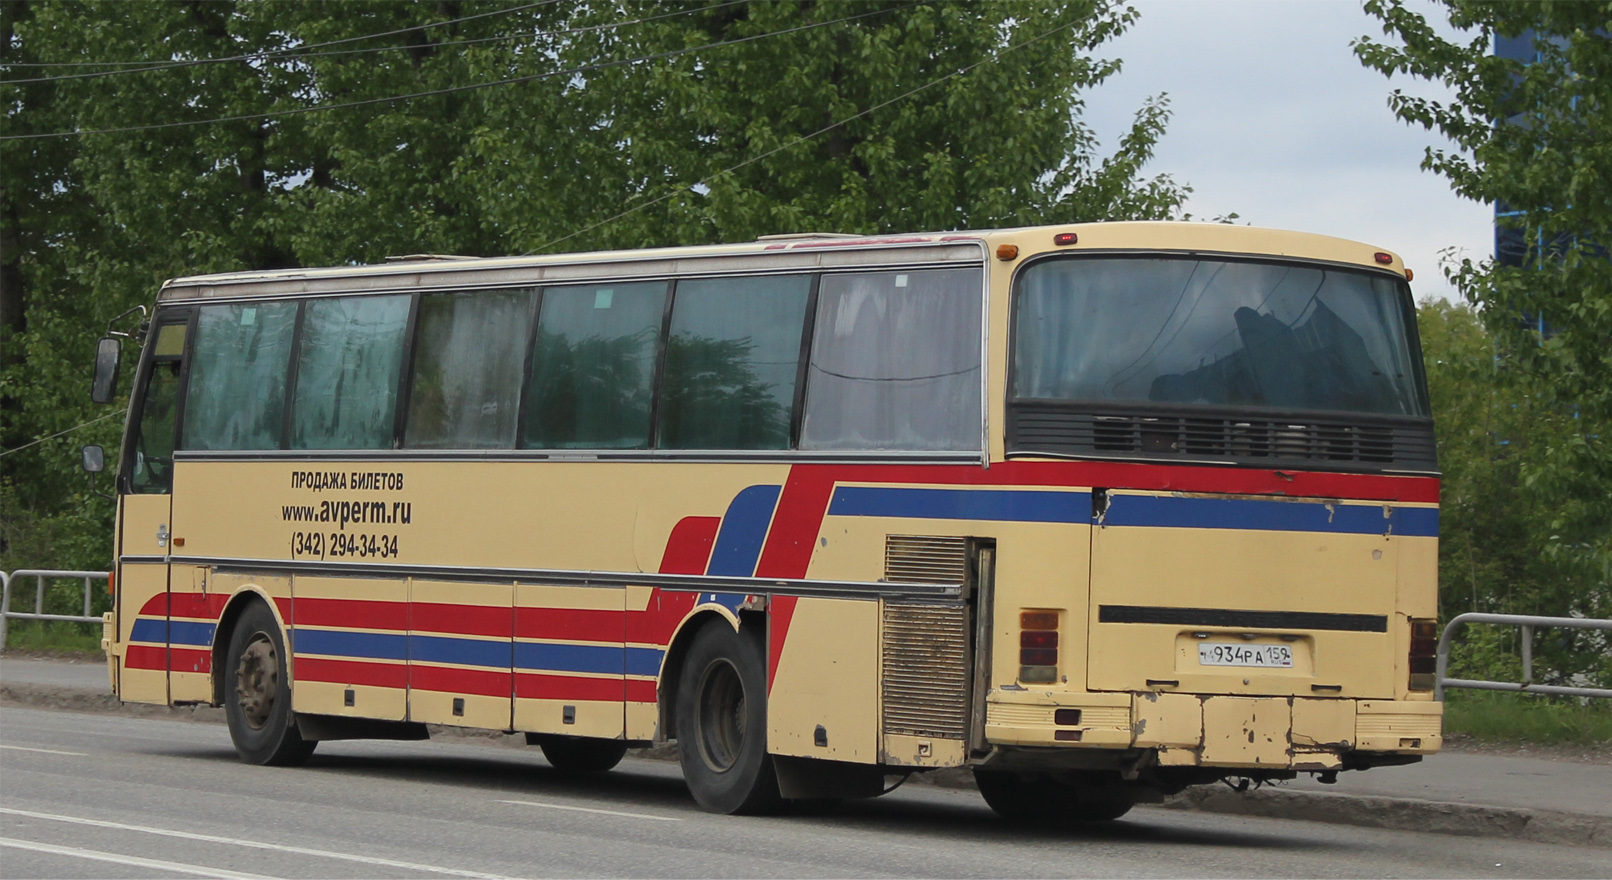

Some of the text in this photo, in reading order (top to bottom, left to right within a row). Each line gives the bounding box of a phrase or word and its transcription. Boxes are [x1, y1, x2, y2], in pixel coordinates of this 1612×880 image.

[291, 471, 404, 492] ПРОДАЖА БИЛЕТОВ
[282, 500, 411, 530] www.avperm.ru
[291, 531, 398, 561] (342) 294-34-34
